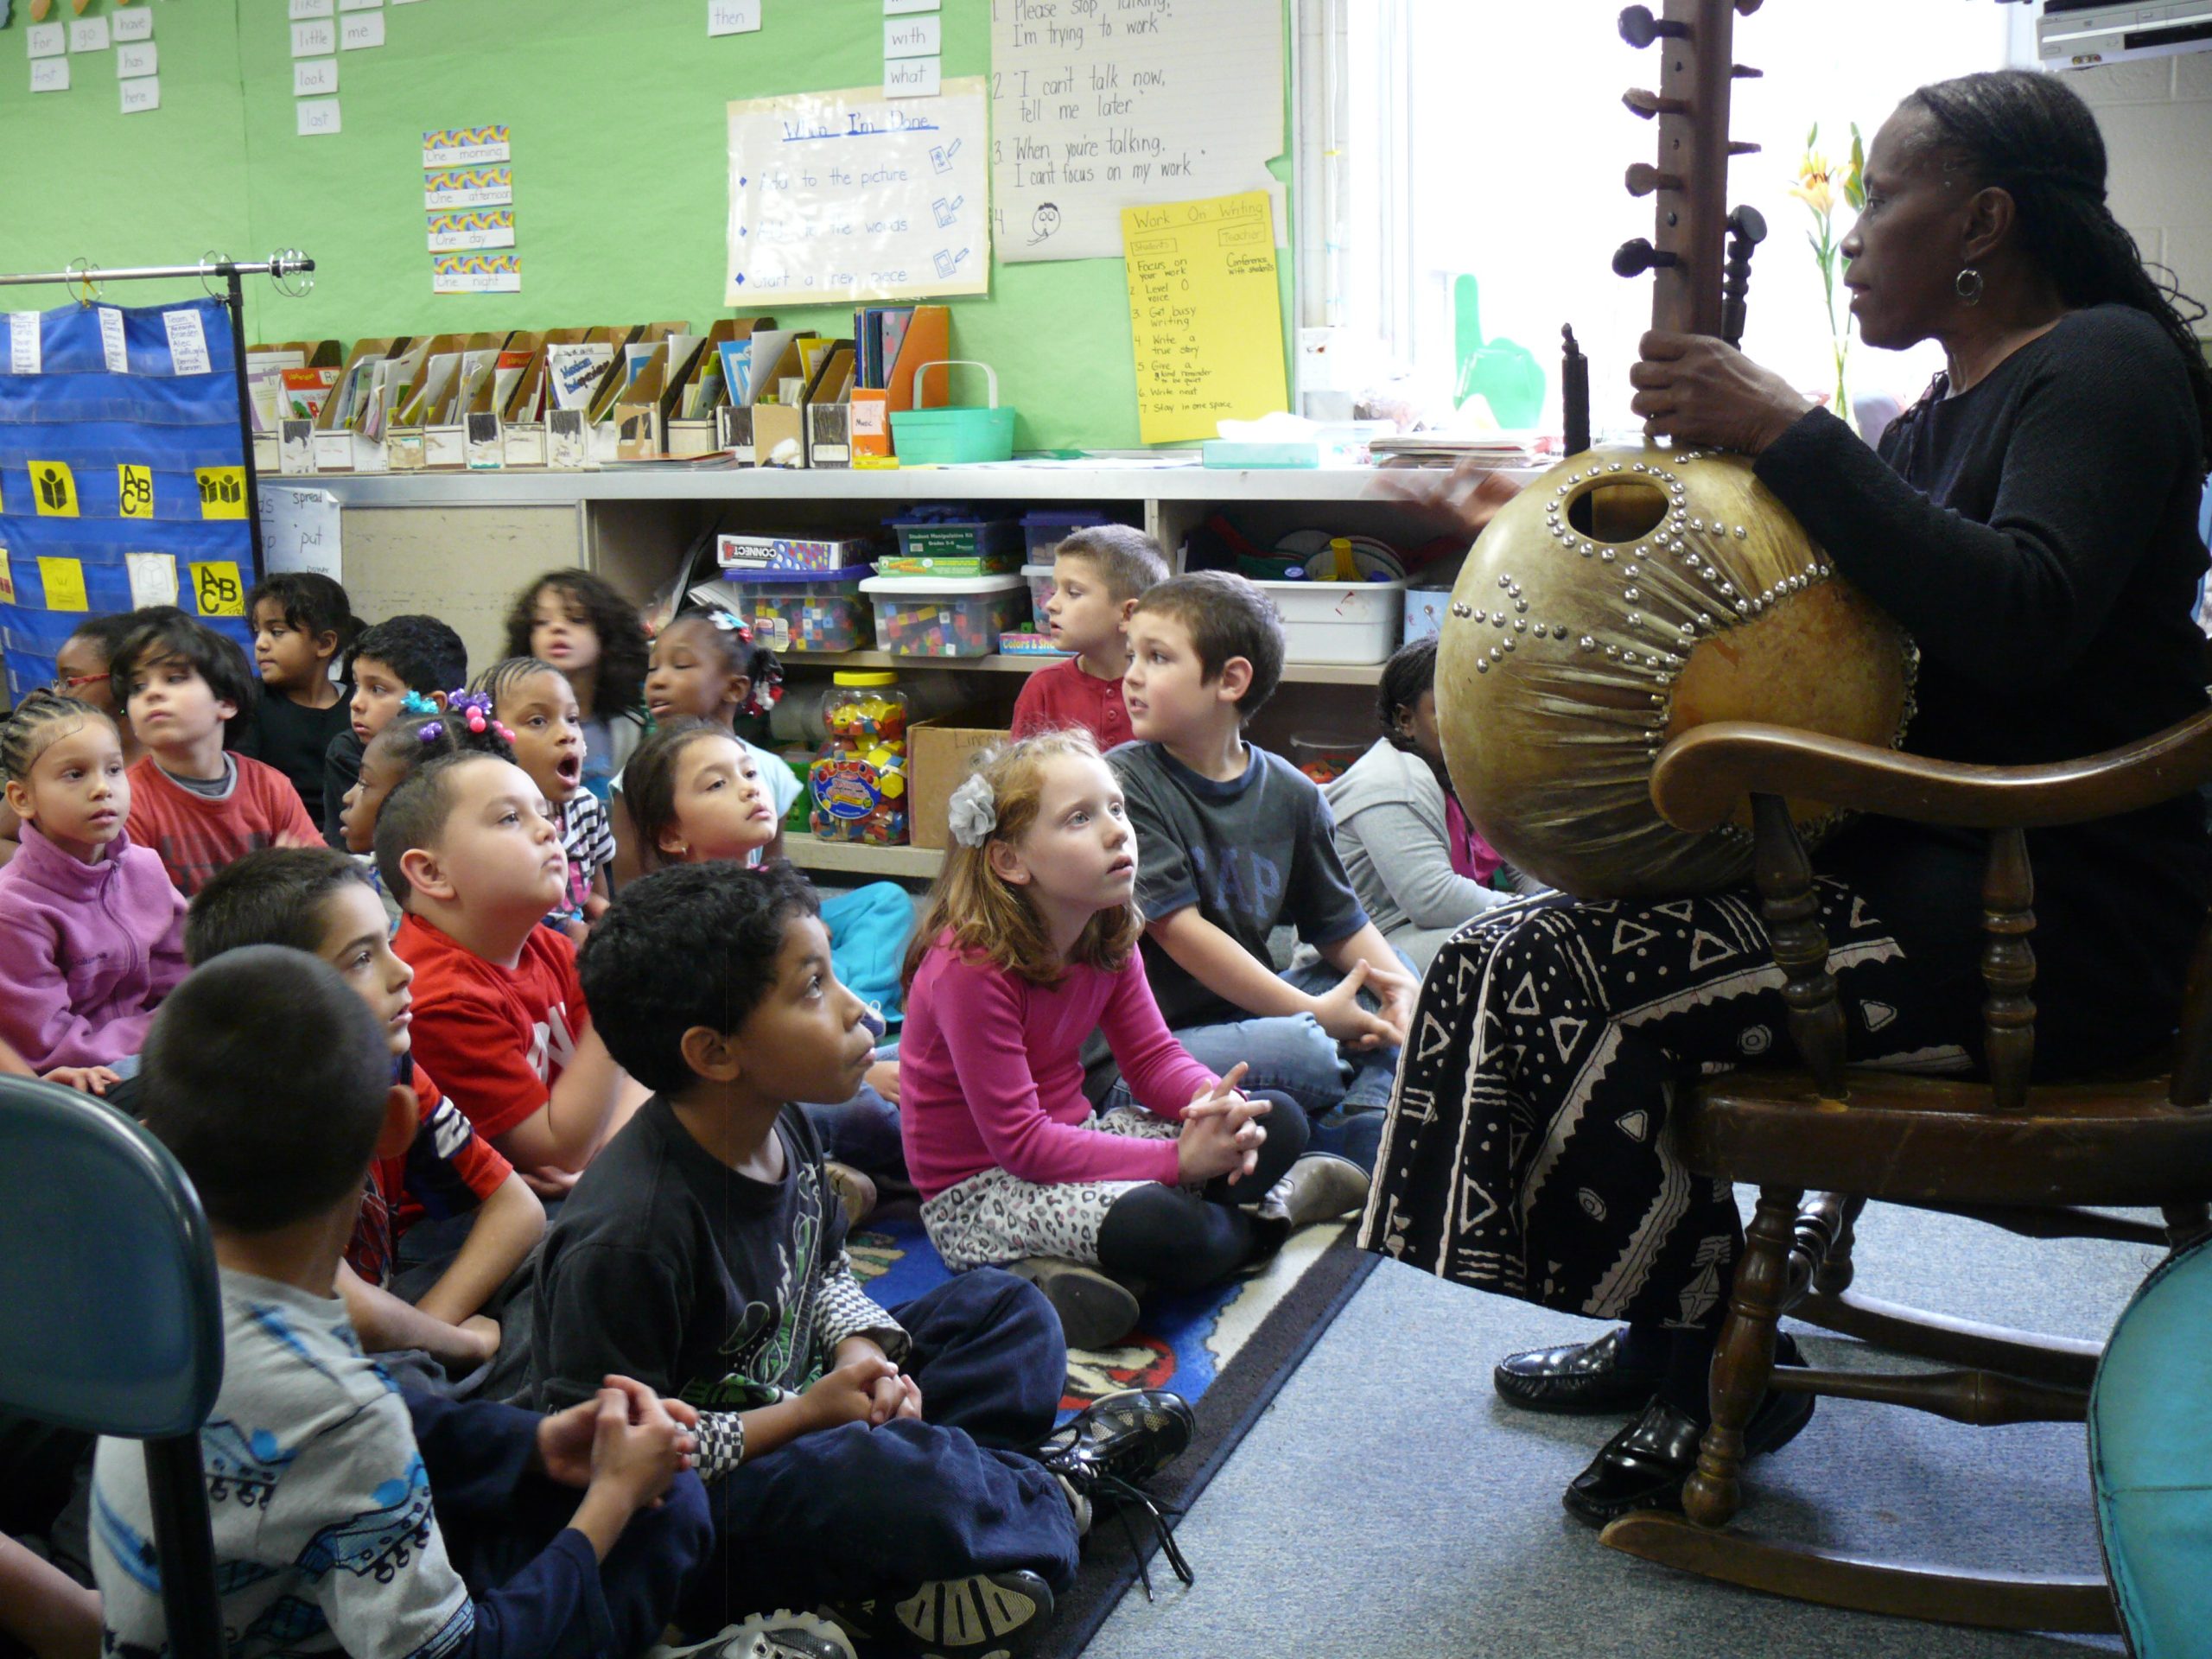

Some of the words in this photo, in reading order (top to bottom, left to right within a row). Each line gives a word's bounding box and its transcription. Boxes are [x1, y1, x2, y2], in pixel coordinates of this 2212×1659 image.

[714, 6, 745, 26] then
[1014, 0, 1057, 21] Please
[120, 17, 146, 30] have
[1013, 22, 1037, 48] I'm
[1047, 20, 1084, 51] trying
[1097, 13, 1112, 37] to
[33, 31, 54, 50] for
[79, 29, 97, 48] go
[299, 29, 327, 48] little
[347, 26, 370, 39] me
[892, 26, 926, 46] with
[124, 51, 144, 69] has
[299, 68, 325, 86] look
[890, 64, 926, 85] what
[1043, 65, 1074, 96] can't
[1088, 63, 1118, 91] talk
[124, 88, 147, 105] here
[306, 109, 328, 127] last
[1019, 98, 1041, 124] tell
[1058, 104, 1079, 119] me
[847, 111, 875, 134] I'm
[891, 110, 931, 130] Done
[425, 151, 447, 162] One
[459, 147, 503, 162] morning
[1013, 135, 1050, 161] When
[1065, 133, 1098, 163] you're
[802, 169, 817, 187] to
[829, 167, 851, 186] the
[861, 164, 908, 188] picture
[1014, 162, 1026, 188] I
[1030, 161, 1056, 186] can't
[1063, 162, 1095, 184] focus
[1107, 166, 1122, 181] on
[1132, 163, 1151, 185] my
[429, 192, 454, 205] One
[1133, 209, 1170, 228] Work
[1187, 205, 1207, 222] On
[1218, 200, 1264, 221] Writing
[435, 232, 456, 246] One
[469, 232, 486, 248] day
[1137, 260, 1166, 272] Focus
[1173, 258, 1188, 267] on
[1164, 266, 1187, 277] work
[1228, 266, 1245, 276] with
[435, 274, 459, 288] One
[472, 276, 499, 291] night
[804, 275, 814, 287] a
[1146, 282, 1169, 295] Level
[1147, 294, 1170, 303] voice
[1148, 306, 1165, 319] Get
[1172, 304, 1197, 318] busy
[1150, 315, 1190, 332] writing
[1152, 334, 1176, 346] Write
[1151, 346, 1172, 355] true
[1179, 345, 1199, 359] story
[1151, 359, 1171, 372] Give
[1149, 387, 1173, 397] Write
[1179, 386, 1198, 396] neat
[1154, 403, 1175, 413] Stay
[1209, 401, 1233, 411] space
[292, 490, 323, 510] spread
[300, 524, 323, 554] put
[733, 545, 777, 558] CONNECT
[1002, 638, 1030, 650] Colors
